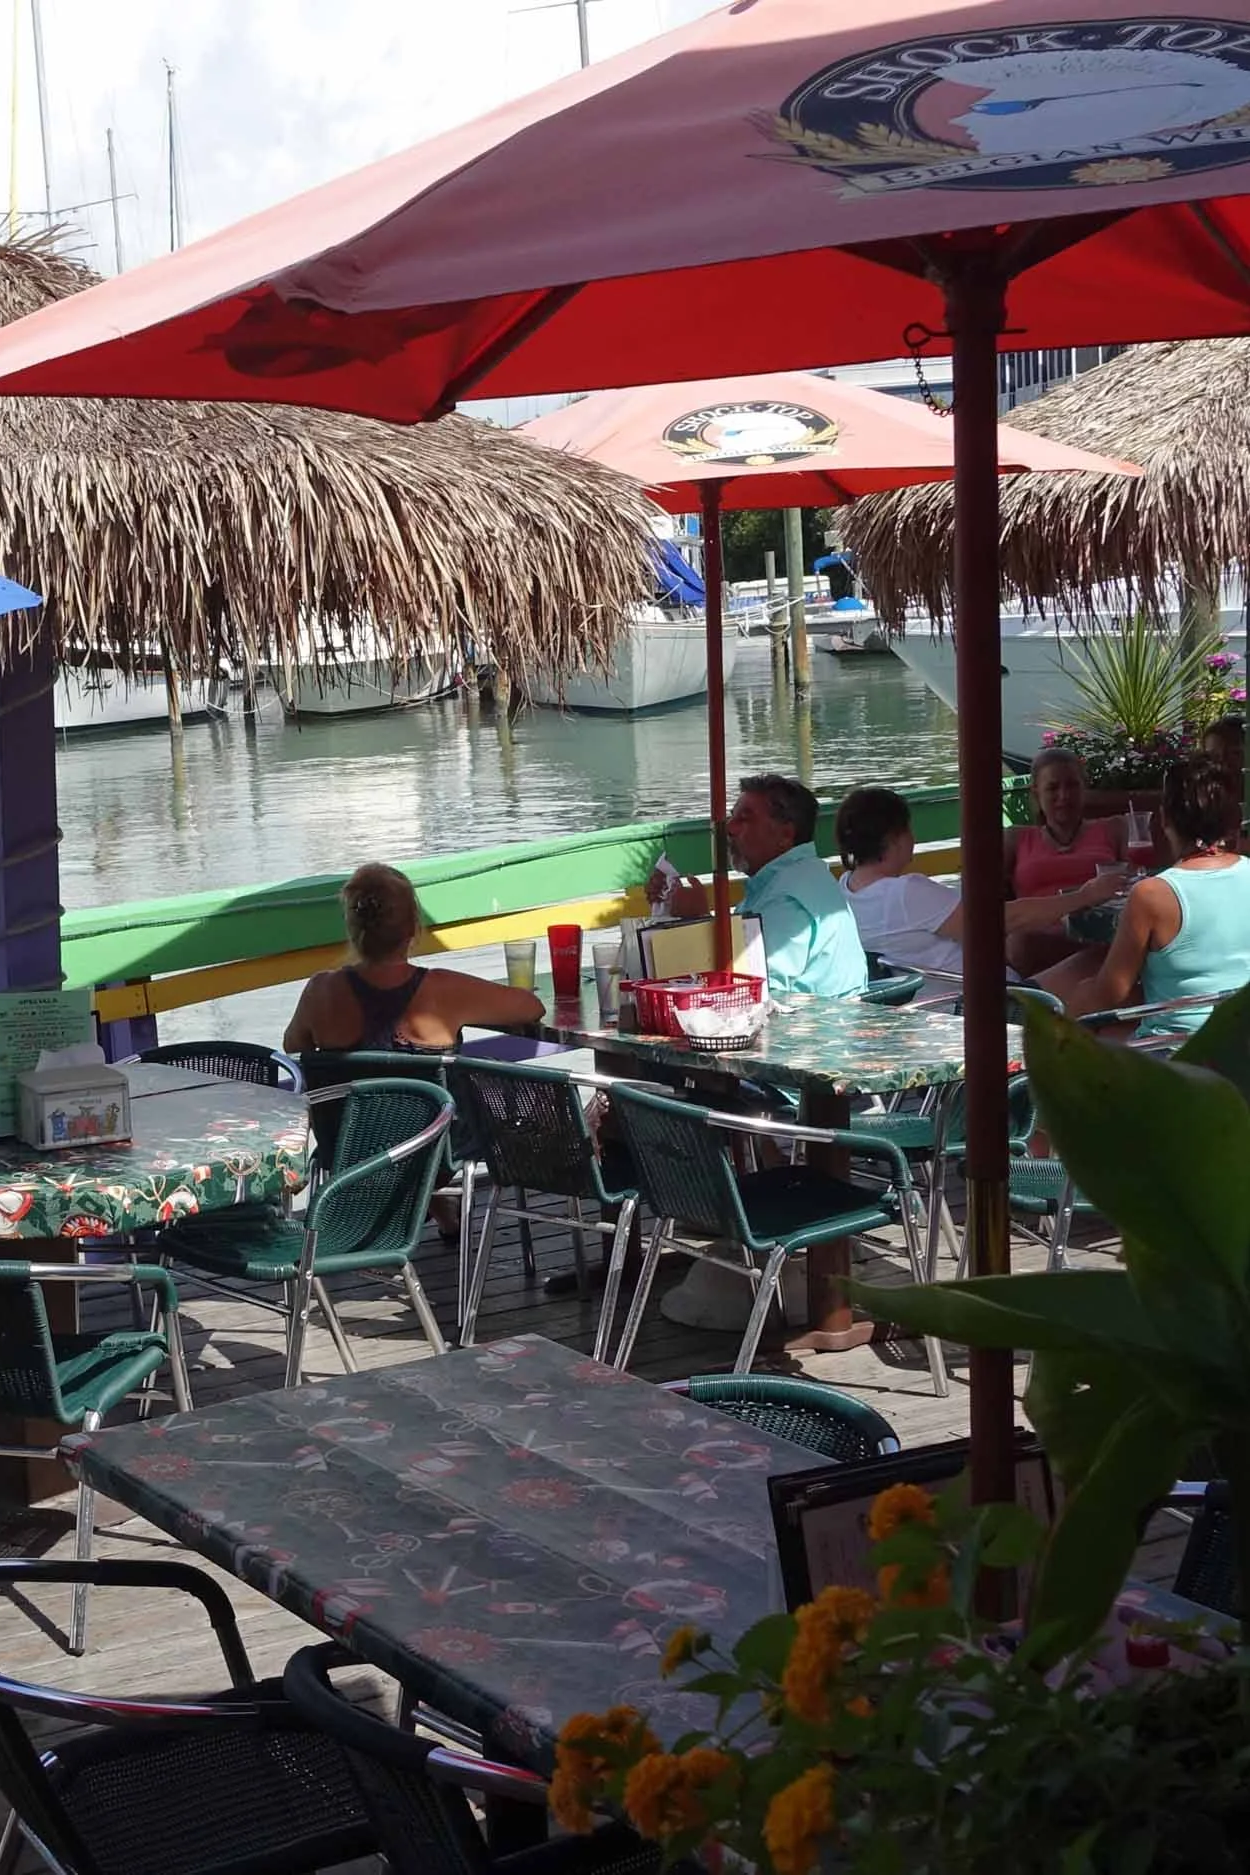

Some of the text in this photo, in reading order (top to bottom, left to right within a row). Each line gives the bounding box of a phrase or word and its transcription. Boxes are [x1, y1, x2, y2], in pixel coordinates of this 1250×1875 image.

[822, 28, 1076, 102] SHOCK
[878, 144, 1124, 186] BELGIAN
[673, 403, 815, 433] SHOCK TOP
